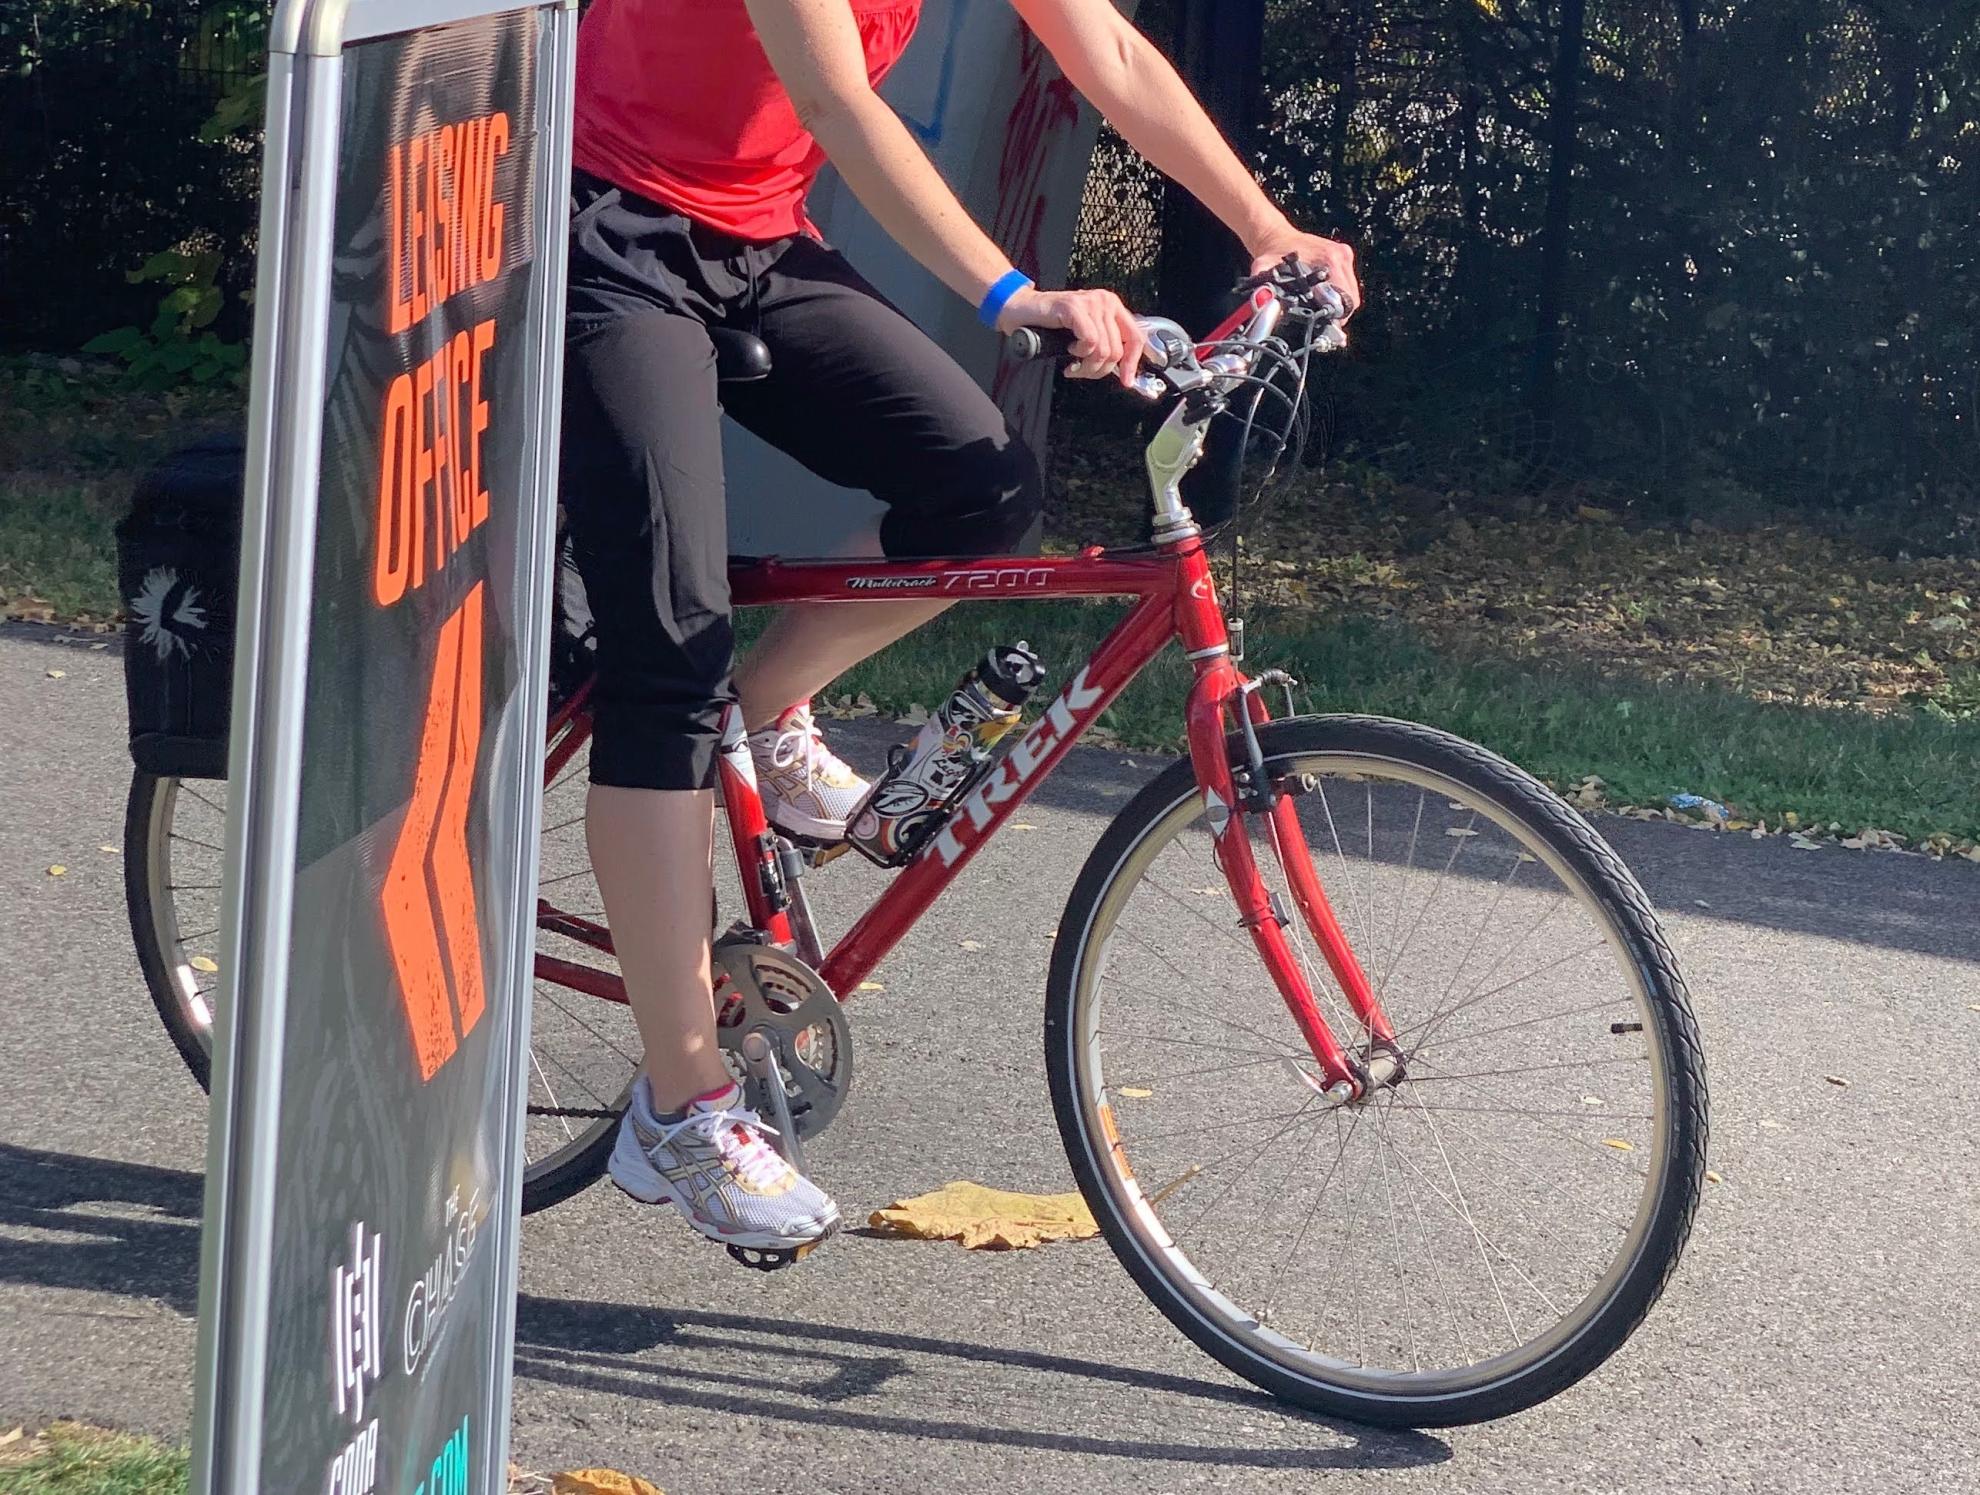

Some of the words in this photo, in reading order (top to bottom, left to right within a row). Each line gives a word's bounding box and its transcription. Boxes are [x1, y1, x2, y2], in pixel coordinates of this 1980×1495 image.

[388, 112, 509, 334] LEASING
[375, 319, 496, 606] OFFICE
[943, 567, 1056, 590] 7200
[923, 664, 1104, 868] TREK
